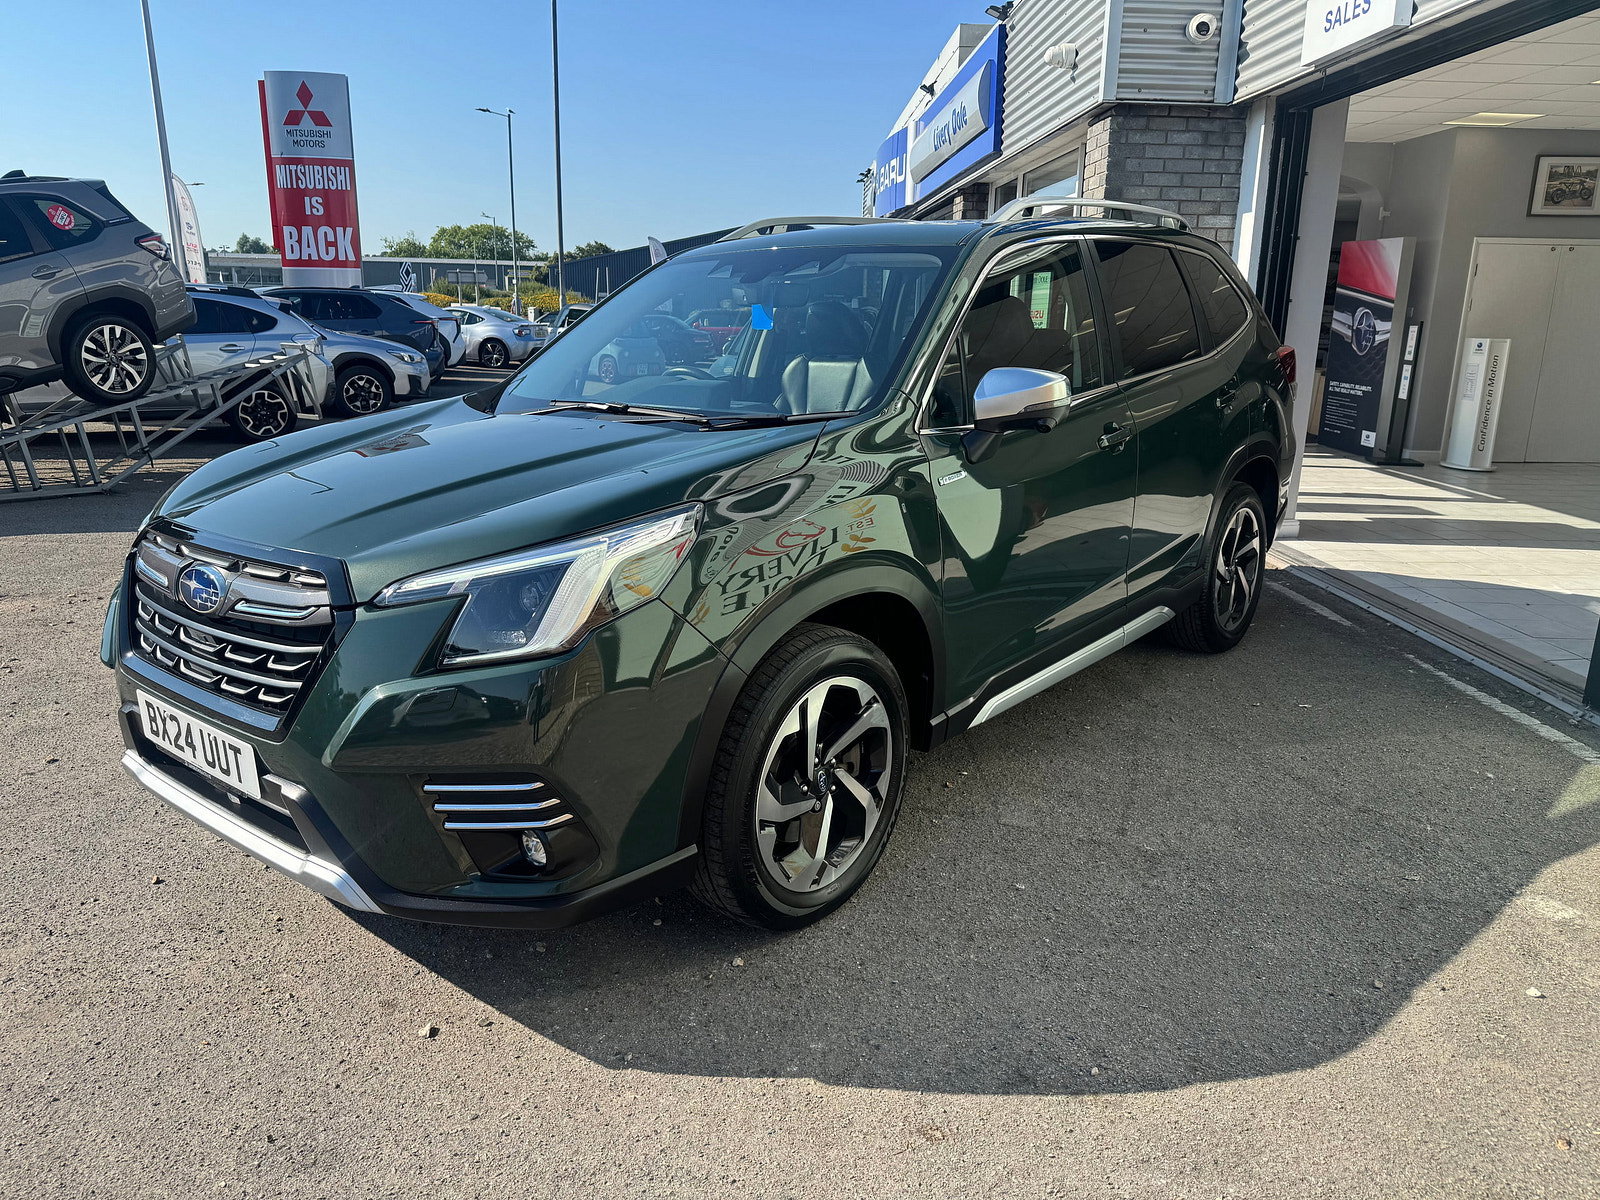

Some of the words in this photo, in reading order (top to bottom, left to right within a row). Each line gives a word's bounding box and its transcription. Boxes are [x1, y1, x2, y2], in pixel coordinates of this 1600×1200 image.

[1324, 0, 1371, 33] SALES
[286, 129, 332, 139] MITSUBISHI
[933, 121, 952, 152] Livery
[951, 101, 968, 136] Dole
[292, 139, 326, 149] MOTORS
[275, 164, 351, 191] MITSUBISHI
[875, 153, 907, 194] BARU
[304, 196, 324, 216] IS
[282, 225, 357, 261] BACK
[1487, 354, 1499, 388] Motion
[1487, 389, 1494, 398] in
[1477, 399, 1492, 452] Confidence
[144, 700, 197, 759] BX24
[199, 728, 243, 784] UUT
